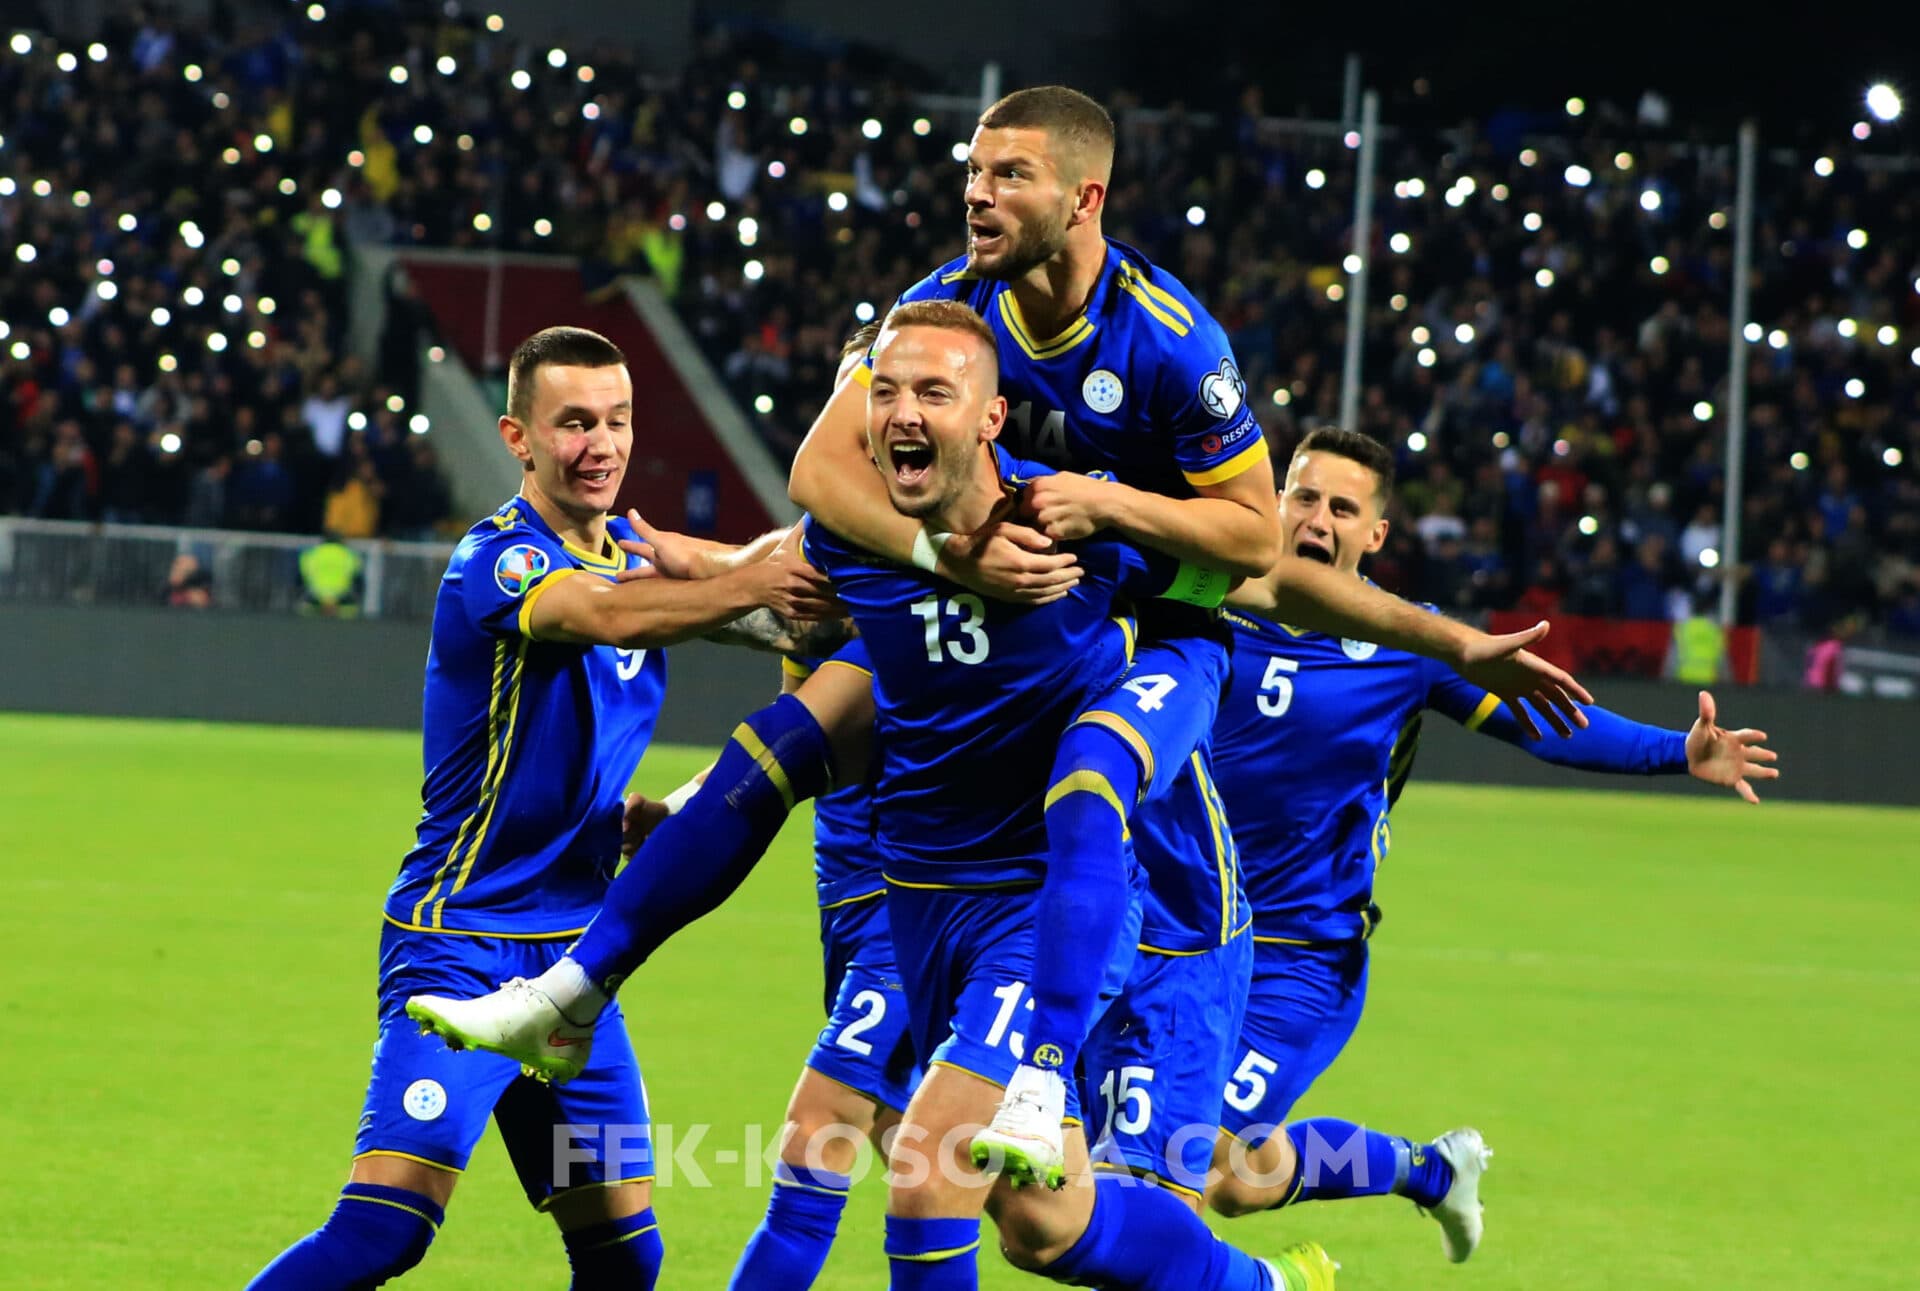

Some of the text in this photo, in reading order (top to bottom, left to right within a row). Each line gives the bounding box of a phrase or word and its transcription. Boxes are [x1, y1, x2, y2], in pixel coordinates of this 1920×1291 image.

[1006, 400, 1073, 460] 14
[910, 592, 990, 665] 13
[1120, 673, 1179, 714] 4
[1256, 656, 1299, 718] 5
[836, 989, 887, 1056] 2
[1099, 1066, 1155, 1136] 15
[1223, 1049, 1278, 1112] 5
